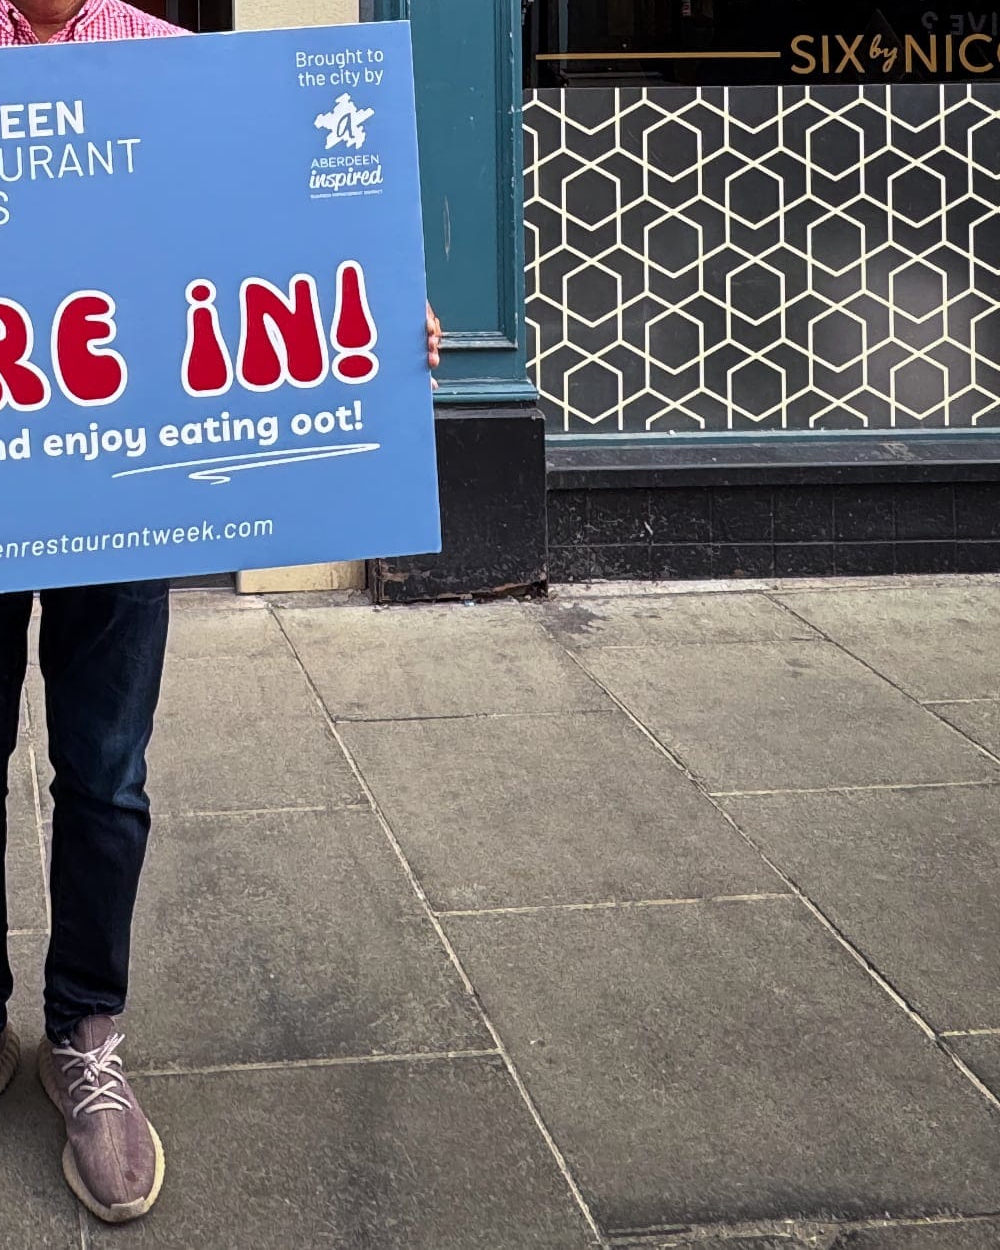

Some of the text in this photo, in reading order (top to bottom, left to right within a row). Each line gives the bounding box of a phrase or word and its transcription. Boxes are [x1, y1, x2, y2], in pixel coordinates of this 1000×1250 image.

[295, 48, 384, 68] Brought to
[790, 34, 865, 74] SIX
[869, 34, 898, 72] by
[298, 67, 384, 87] the city by
[310, 154, 380, 168] ABERDEEN
[309, 164, 384, 191] inspired
[43, 424, 147, 458] enjoy
[158, 411, 279, 447] eating
[290, 400, 364, 436] oot!
